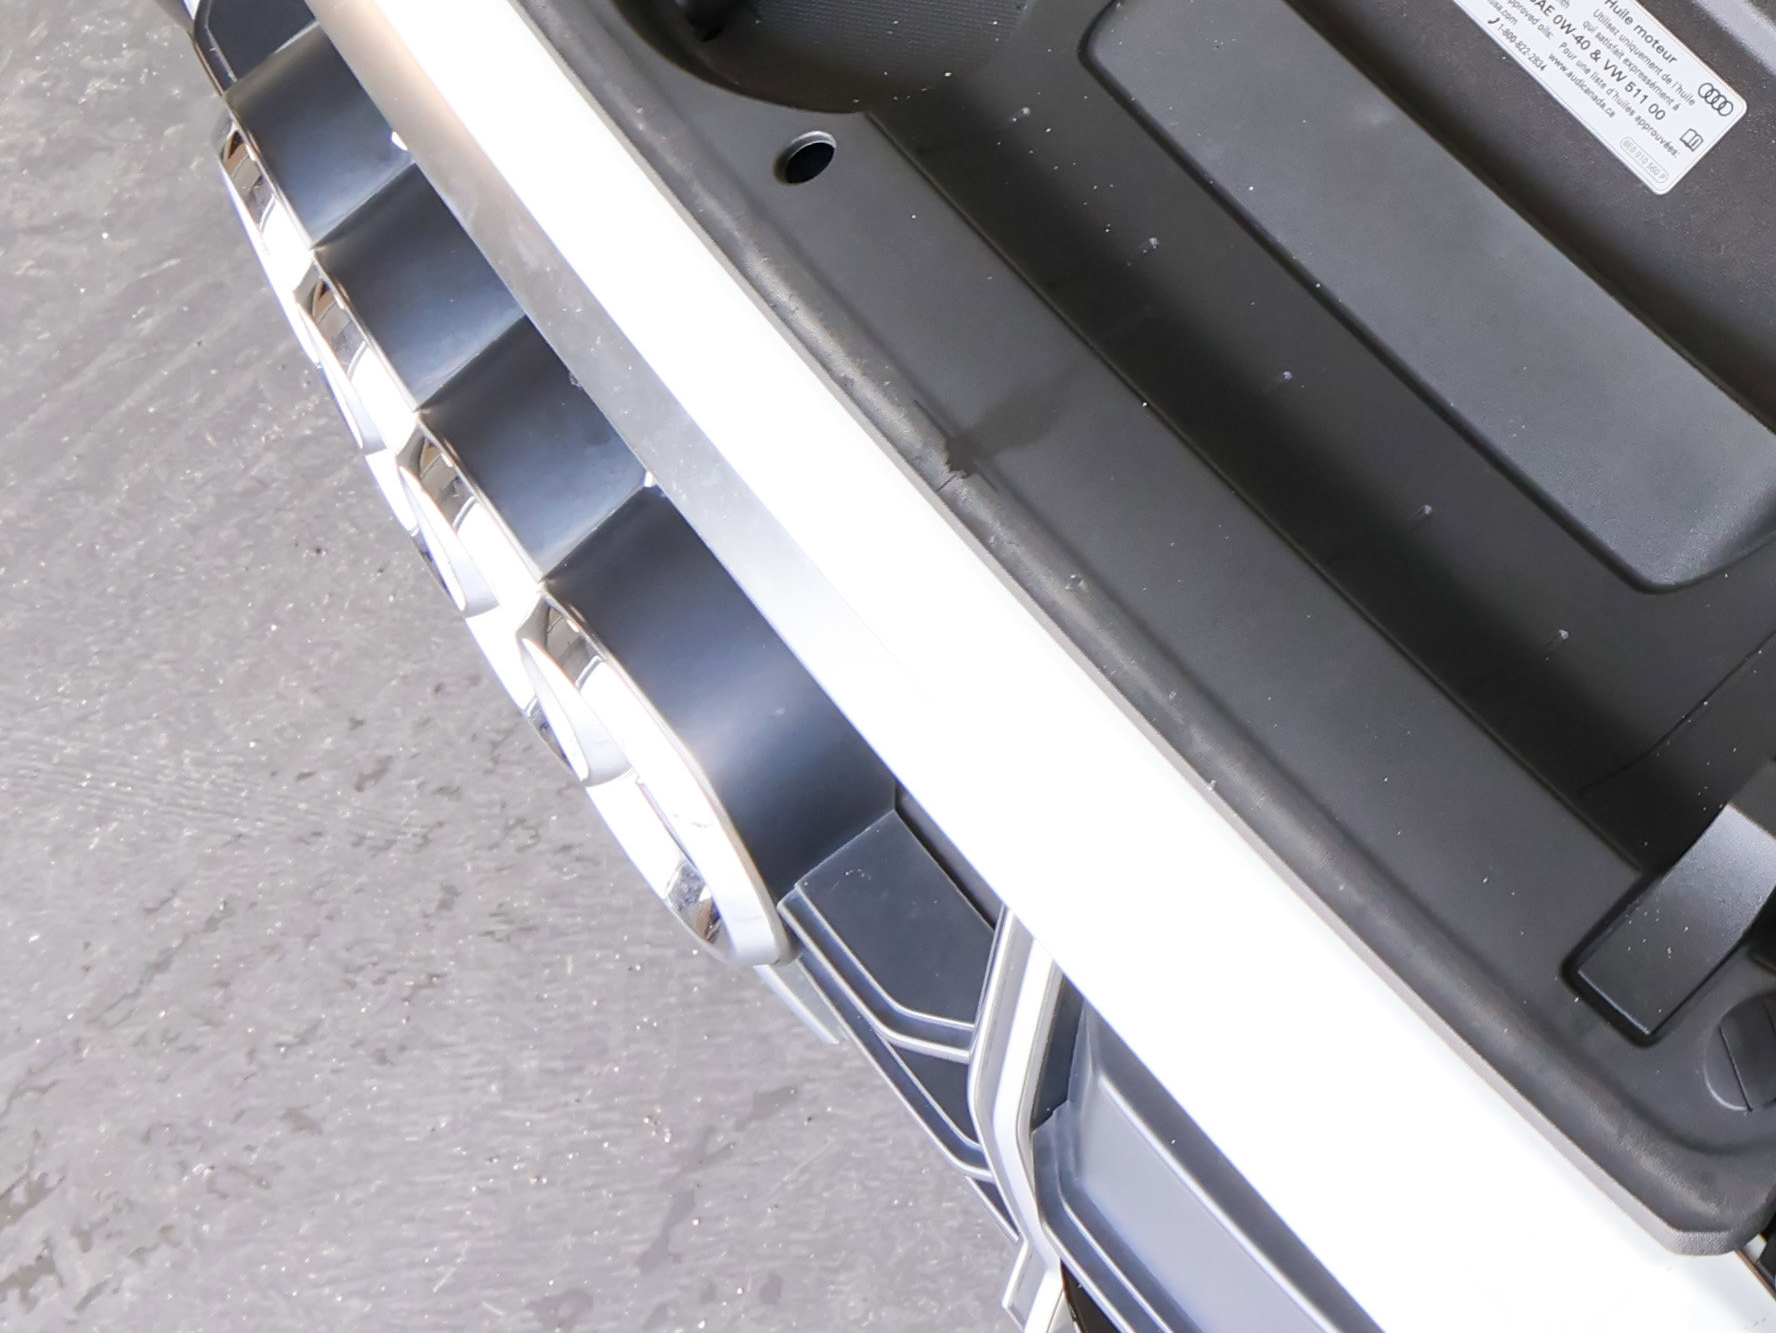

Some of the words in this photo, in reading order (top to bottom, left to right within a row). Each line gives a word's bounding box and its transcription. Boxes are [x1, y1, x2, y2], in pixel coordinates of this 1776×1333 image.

[1497, 24, 1546, 71] 1-800-822-2834
[1537, 23, 1554, 39] oils:
[1553, 14, 1590, 50] 0W-40
[1590, 49, 1602, 61] &
[1602, 60, 1625, 82] VW
[1625, 82, 1647, 102] 511
[1648, 103, 1665, 120] 00
[1582, 20, 1596, 33] qui
[1595, 31, 1624, 58] satisfait
[1622, 57, 1673, 105] expressément
[1592, 10, 1619, 35] Utilisez
[1617, 34, 1662, 75] uniquement
[1661, 72, 1673, 84] de
[1672, 82, 1696, 105] l'huile
[1633, 24, 1676, 63] moteur
[1548, 53, 1615, 117] www.audicanada.ca
[1558, 43, 1576, 60] Pour
[1575, 60, 1589, 74] une
[1590, 72, 1607, 88] liste
[1606, 87, 1635, 116] d'huiles
[1633, 115, 1679, 159] approuvées:
